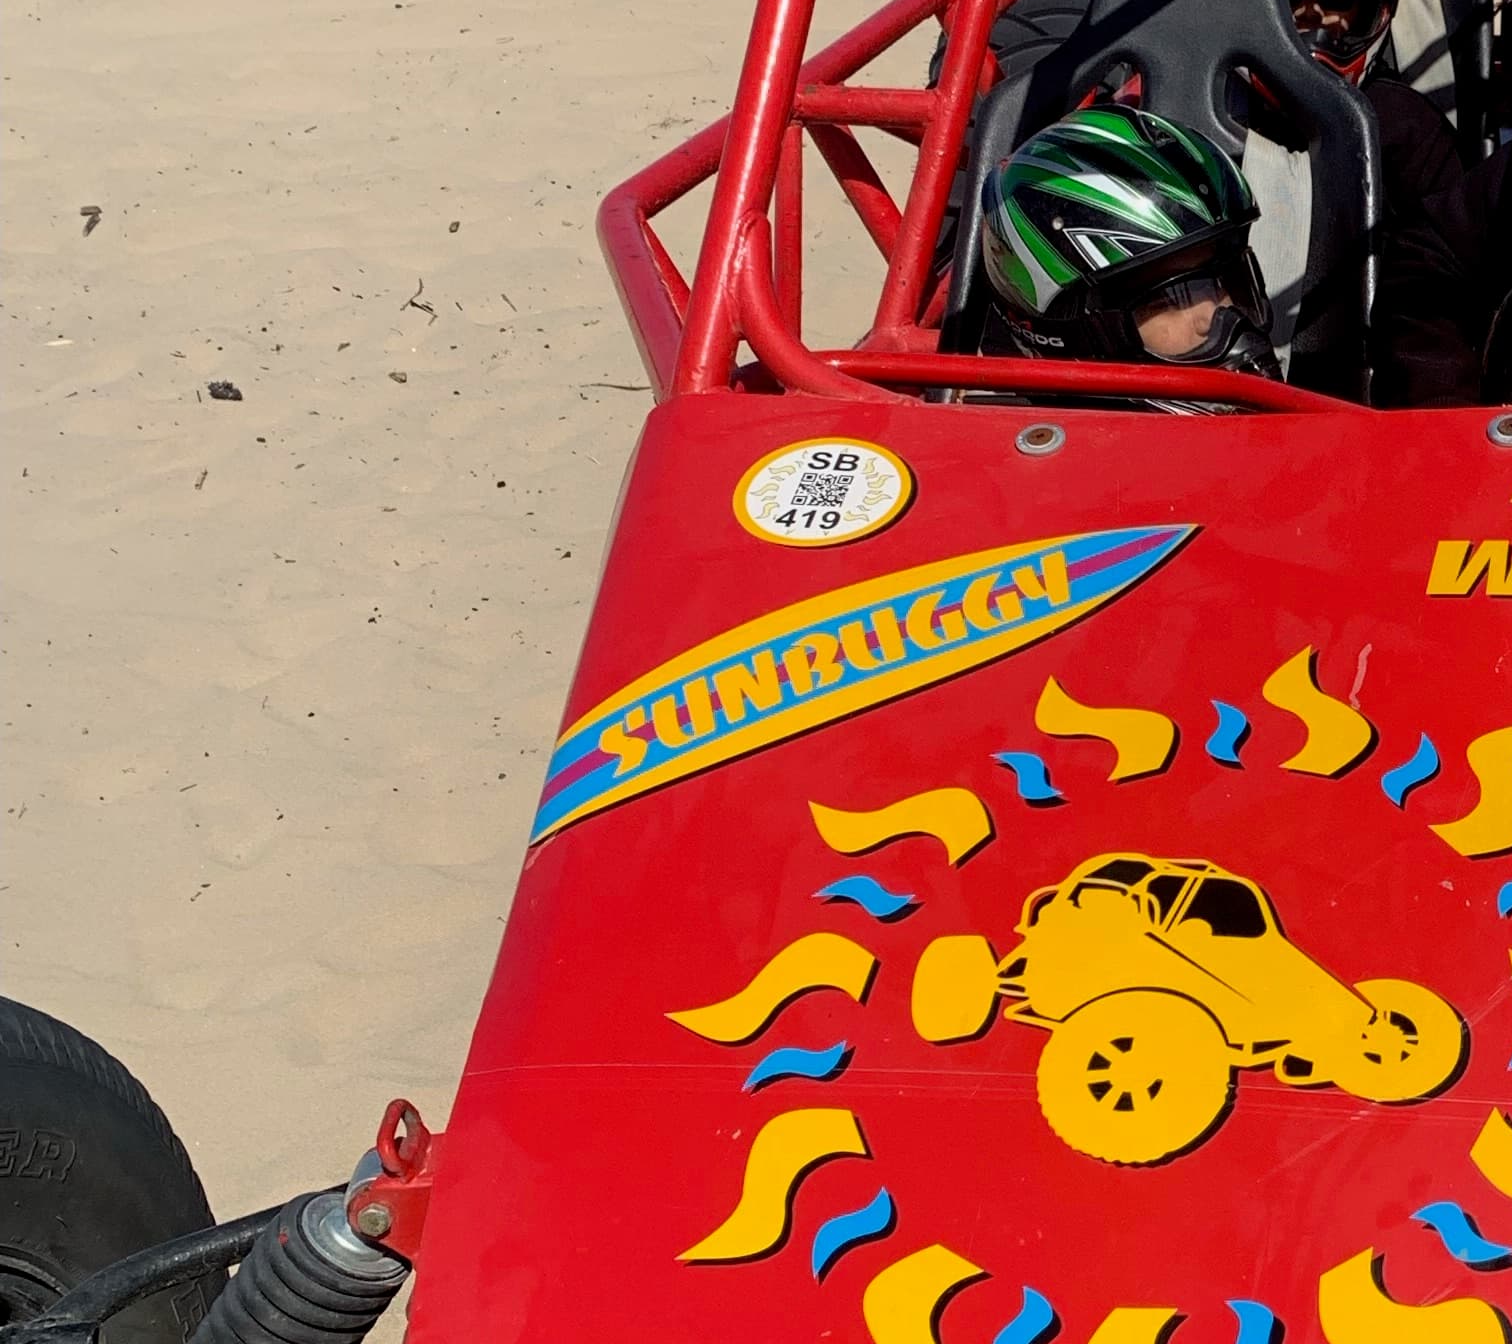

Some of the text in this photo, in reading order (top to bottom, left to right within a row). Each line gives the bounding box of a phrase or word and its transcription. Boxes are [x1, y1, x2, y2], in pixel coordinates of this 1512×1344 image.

[807, 452, 860, 472] SB
[775, 509, 841, 530] 419
[598, 549, 1073, 777] SUNBUGGY
